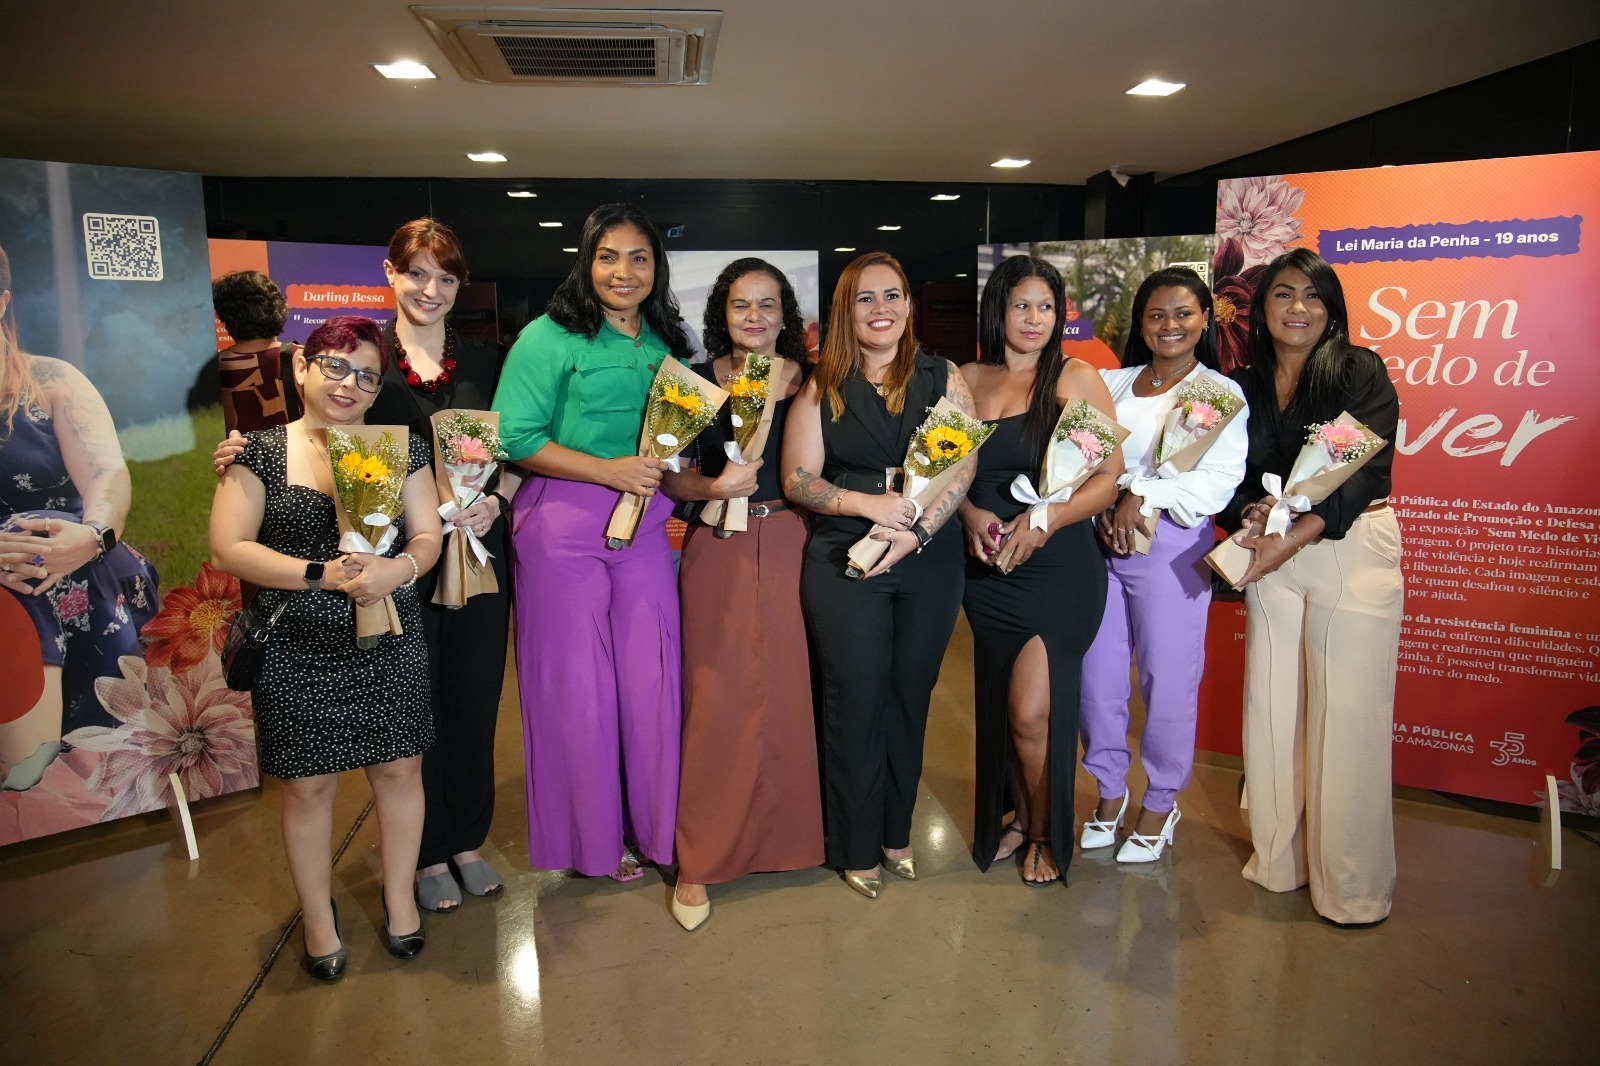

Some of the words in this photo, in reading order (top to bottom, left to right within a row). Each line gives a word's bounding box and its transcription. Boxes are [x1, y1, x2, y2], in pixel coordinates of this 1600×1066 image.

[1336, 240, 1357, 252] Lei
[1361, 237, 1403, 251] Maria
[1407, 236, 1426, 249] da
[1430, 234, 1480, 248] Penha
[1494, 232, 1513, 245] 19
[1516, 231, 1559, 244] anos
[303, 291, 349, 304] Darling
[352, 292, 385, 303] Bessa
[1359, 286, 1520, 341] Sem
[1376, 343, 1478, 386] edo
[1493, 349, 1556, 387] de
[1395, 402, 1578, 467] ver
[1400, 495, 1448, 507] Pública
[1452, 499, 1468, 508] do
[1472, 499, 1518, 511] Estado
[1522, 502, 1540, 512] do
[1444, 511, 1460, 521] de
[1463, 512, 1532, 526] Promoção
[1547, 517, 1594, 530] Defesa
[1419, 524, 1479, 536] exposição
[1520, 529, 1558, 541] Medo
[1562, 532, 1579, 543] de
[1456, 538, 1466, 548] O
[1469, 541, 1514, 552] projeto
[1518, 544, 1542, 554] traz
[1414, 548, 1428, 558] de
[1432, 551, 1484, 563] violência
[1498, 555, 1526, 567] hoje
[1529, 559, 1598, 572] reafirmam
[1403, 561, 1410, 570] à
[1413, 562, 1471, 575] liberdade.
[1474, 566, 1505, 578] Cada
[1509, 569, 1560, 583] imagem
[1563, 576, 1571, 584] e
[1407, 589, 1428, 598] por
[1431, 589, 1467, 602] ajuda.
[1408, 574, 1422, 584] de
[1425, 577, 1458, 587] quem
[1462, 579, 1514, 592] desafiou
[1529, 585, 1579, 598] silêncio
[1582, 591, 1590, 599] e
[1415, 613, 1431, 623] da
[1434, 617, 1506, 631] resistência
[1509, 622, 1571, 638] feminina
[1414, 627, 1446, 638] ainda
[1449, 631, 1501, 645] enfrenta
[1504, 636, 1585, 654] dificuldades.
[1398, 650, 1433, 663] zinha.
[1437, 652, 1444, 664] É
[1447, 657, 1495, 670] possível
[1498, 662, 1575, 680] transformar
[1442, 644, 1505, 658] reafirmem
[1508, 651, 1532, 662] que
[1535, 653, 1593, 668] ninguém
[1418, 665, 1445, 677] livre
[1447, 669, 1462, 679] do
[1465, 673, 1503, 684] medo.
[1393, 722, 1407, 733] IA
[1412, 725, 1474, 743] PÚBLICA
[1406, 736, 1474, 754] AMAZONAS
[1490, 731, 1525, 766] 35
[1511, 757, 1537, 766] ANOS
